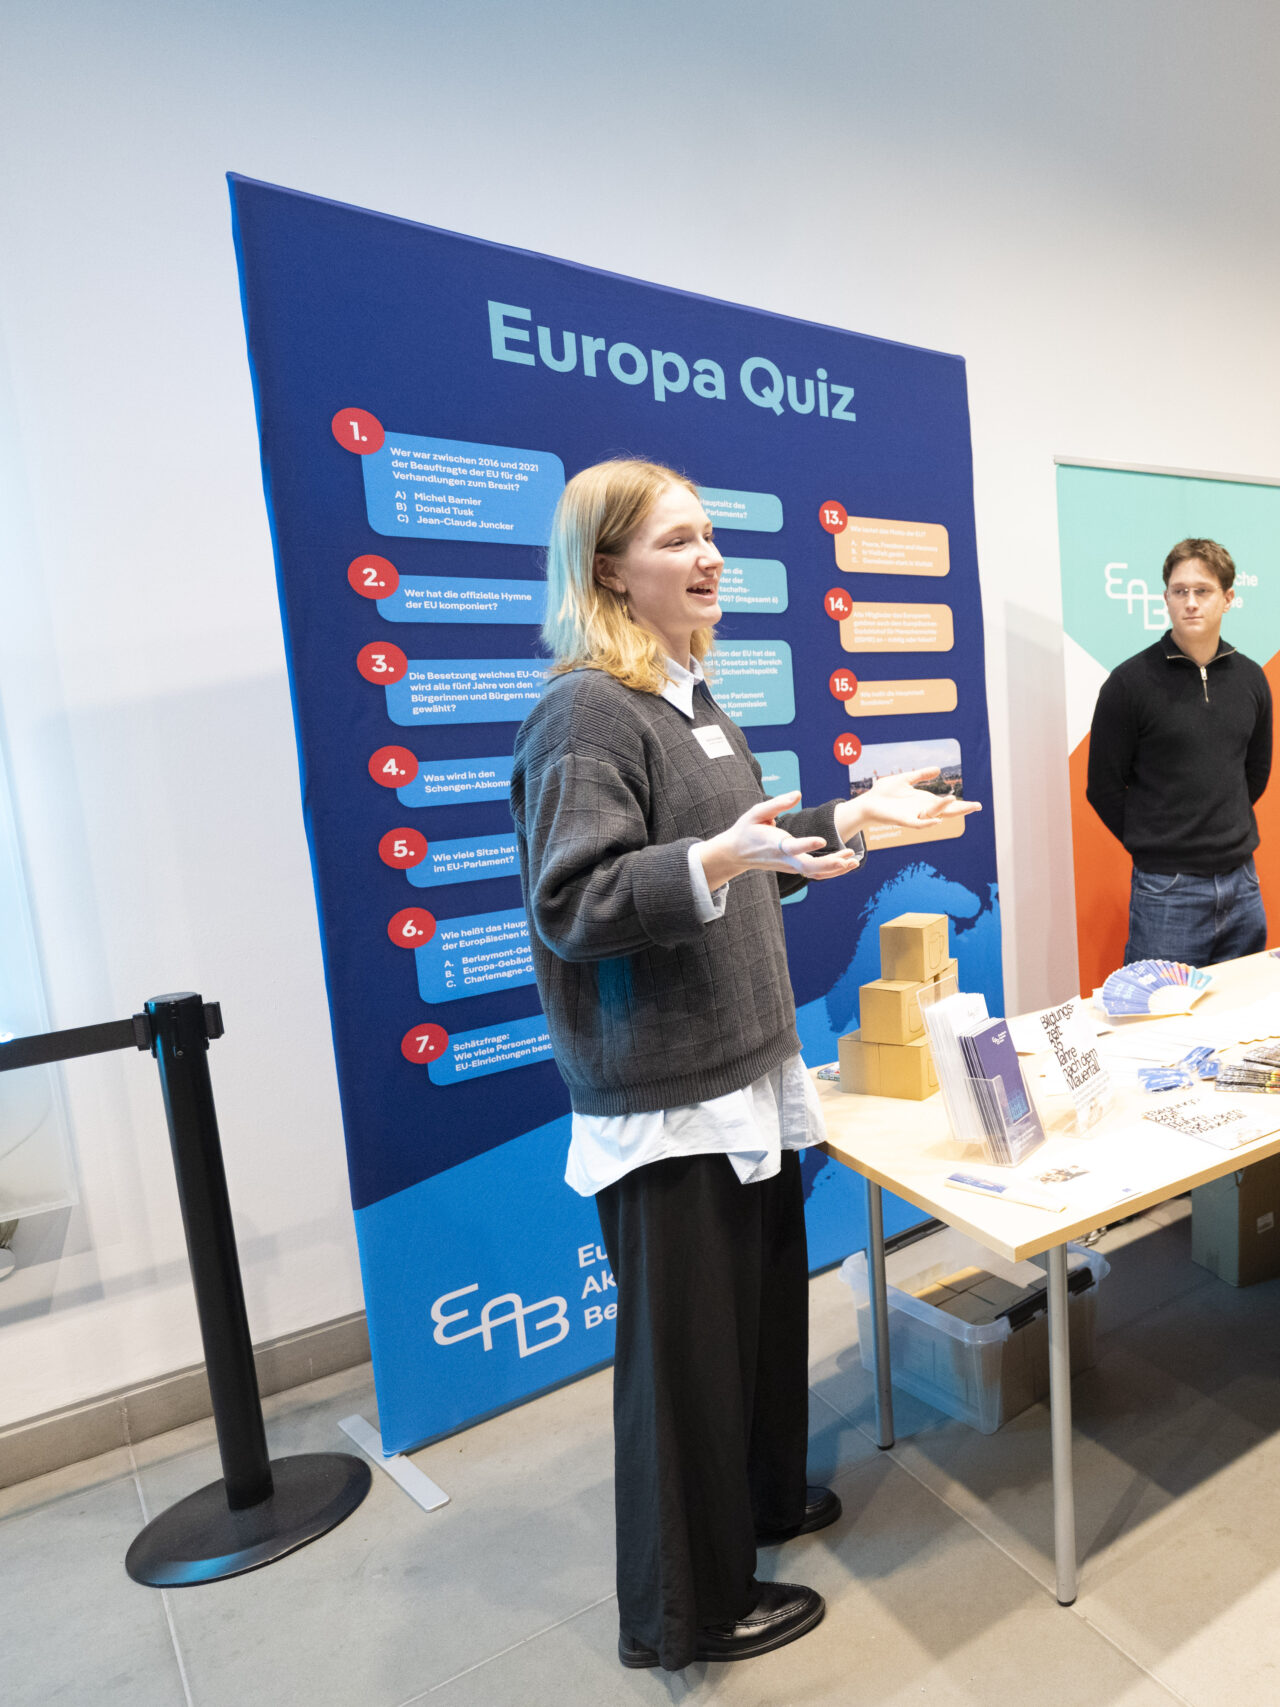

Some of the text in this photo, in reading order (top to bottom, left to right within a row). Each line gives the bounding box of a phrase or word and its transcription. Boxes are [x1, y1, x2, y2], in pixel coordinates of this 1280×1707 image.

[488, 300, 856, 422] Europa Quiz
[350, 421, 368, 442] 1.
[390, 447, 539, 472] Wer war zwischen 2016 und 2021
[392, 460, 528, 482] der Beauftragte der EU für die
[392, 470, 520, 492] Verhandlungen zum Brexit?
[394, 490, 482, 506] A) Michel Barnier
[702, 499, 732, 508] auptsitz
[396, 502, 474, 516] B) Donald Tusk
[824, 510, 843, 525] 13.
[397, 514, 514, 530] C) Jean-Claude Juncker
[362, 568, 386, 587] 2.
[404, 589, 532, 602] Wer hat die offizielle Hymne
[829, 597, 848, 612] 14.
[1104, 562, 1170, 630] EAB
[406, 601, 498, 612] der EU komponiert?
[371, 655, 395, 673] 3.
[409, 670, 549, 681] Die Besetzung welches EU-Org
[410, 682, 431, 691] wird
[433, 682, 450, 691] alle
[452, 681, 471, 690] fünf
[472, 681, 497, 690] Jahre
[517, 681, 533, 689] den
[834, 678, 853, 692] 15.
[411, 692, 468, 703] Bürgerinnen
[470, 692, 487, 700] und
[489, 691, 523, 701] Bürgern
[413, 704, 456, 715] gewählt?
[838, 742, 857, 756] 16.
[382, 758, 406, 776] 4.
[424, 774, 445, 782] Was
[446, 772, 467, 781] wird
[424, 780, 511, 793] Schengen-Abkomm
[393, 840, 415, 858] 5.
[433, 852, 451, 862] Wie
[453, 851, 475, 860] viele
[477, 848, 499, 858] Sitze
[500, 846, 515, 854] hat
[434, 856, 515, 873] im EU-Parlament?
[402, 920, 424, 937] 6.
[441, 931, 459, 940] Wie
[461, 928, 484, 938] heißt
[486, 925, 502, 934] das
[442, 942, 458, 951] der
[459, 932, 519, 948] Europäischen
[444, 960, 454, 968] A.
[445, 956, 532, 978] B. Europa-Gebäud
[446, 966, 534, 988] C. Charlemagne-G
[1040, 1004, 1074, 1029] Bildungs-
[416, 1035, 434, 1053] 7.
[453, 1033, 510, 1052] Schätzfrage:
[454, 1034, 550, 1062] Wie viele Personen sin
[455, 1044, 552, 1071] EU-Einrichtungen besc
[578, 1243, 608, 1268] Eu
[581, 1270, 616, 1300] Ak
[430, 1283, 570, 1358] EAB
[584, 1303, 617, 1329] Be
